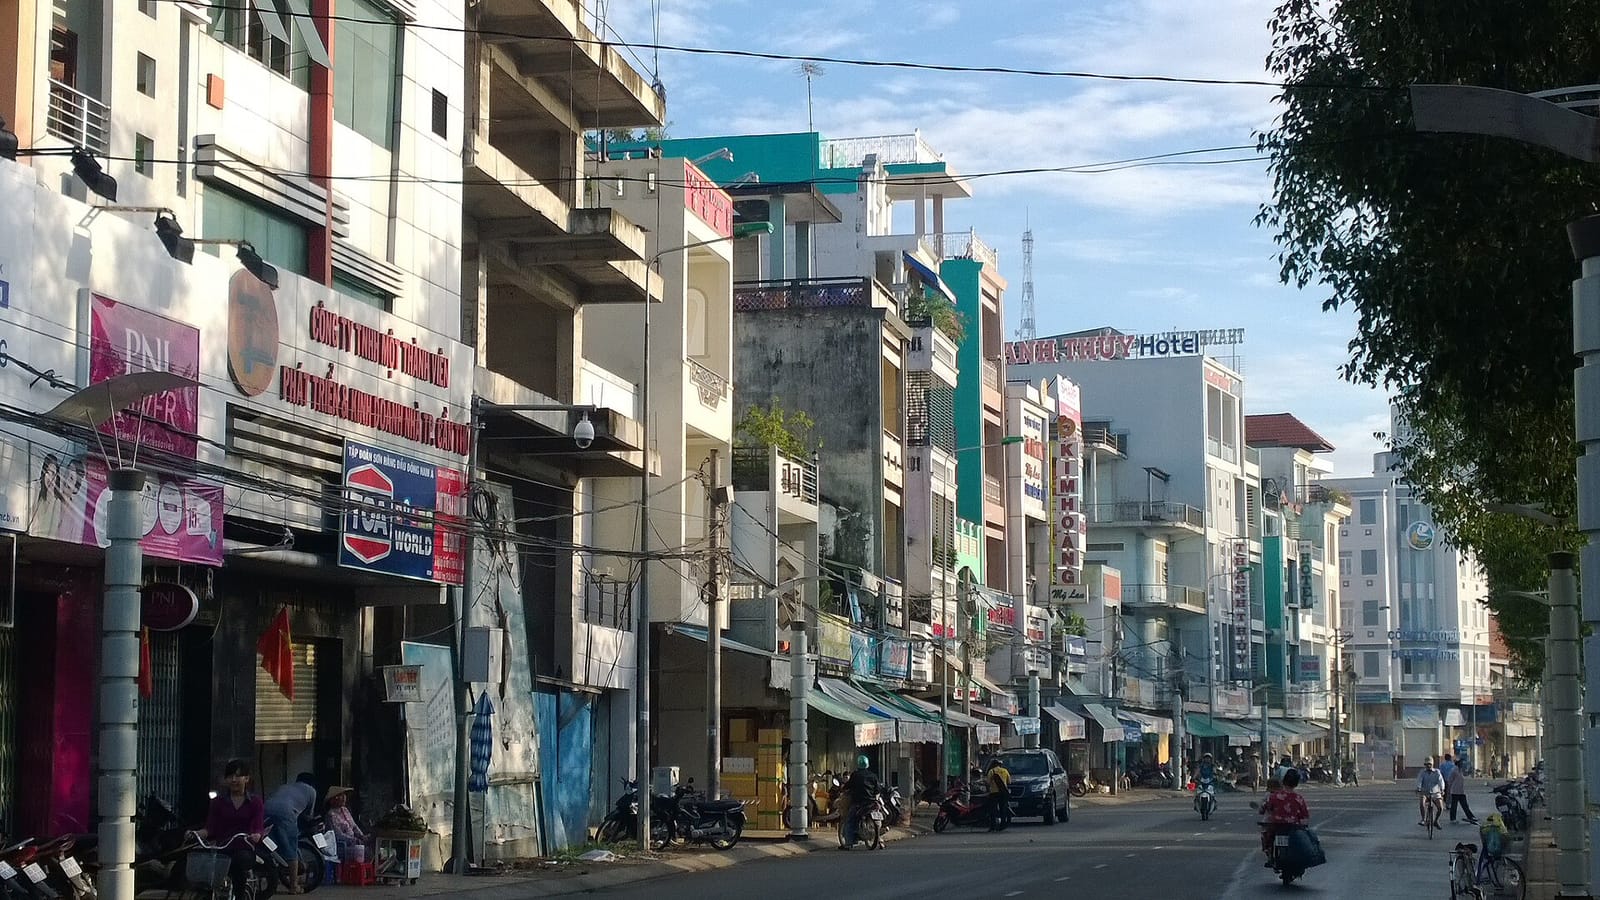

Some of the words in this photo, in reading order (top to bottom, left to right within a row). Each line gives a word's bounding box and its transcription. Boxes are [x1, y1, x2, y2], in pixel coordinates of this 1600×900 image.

[310, 300, 338, 348] CÔNG
[338, 316, 353, 352] TY
[353, 323, 379, 362] TNHH
[378, 328, 401, 379] MỘT
[400, 337, 431, 382] THÀNH
[429, 347, 449, 389] VIÊN
[1139, 333, 1200, 357] Hotel
[280, 362, 310, 407] PHÁT
[310, 363, 339, 417] TRIỂN
[338, 384, 349, 421] &
[348, 388, 374, 428] KINH
[373, 396, 404, 438] DOANH
[403, 401, 421, 442] NHÀ
[434, 406, 452, 451] CẦN
[348, 445, 359, 459] TẬP
[349, 491, 388, 536] TOA
[395, 529, 432, 556] WORLD
